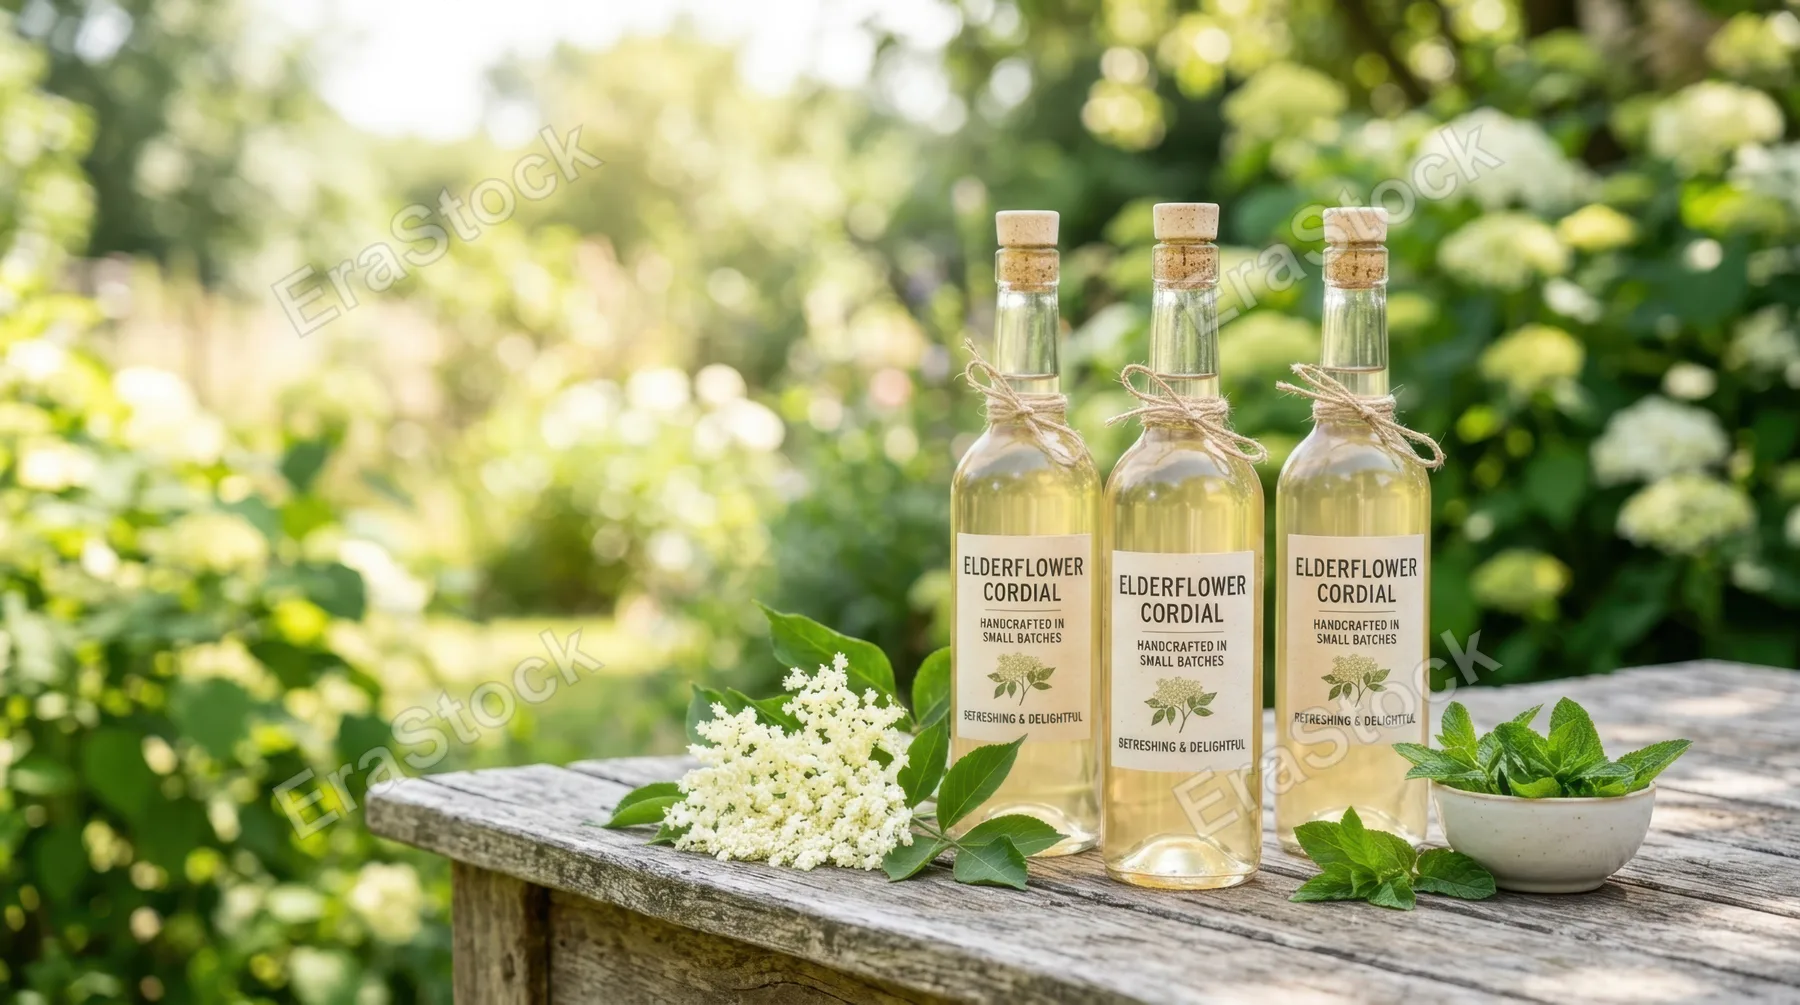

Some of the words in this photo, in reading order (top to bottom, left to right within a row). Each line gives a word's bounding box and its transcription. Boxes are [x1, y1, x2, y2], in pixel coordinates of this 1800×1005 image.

[964, 556, 1083, 577] ELDERFLOWER
[1296, 557, 1417, 578] ELDERFLOWER
[984, 582, 1061, 602] CORDIAL
[1120, 575, 1246, 597] ELDERFLOWER
[1318, 583, 1396, 603] CORDIAL
[1141, 602, 1224, 623] CORDIAL
[980, 618, 1051, 630] HANDCRAFTED
[1055, 618, 1064, 628] IN
[1314, 619, 1387, 631] HANDCRAFTED
[1390, 619, 1399, 630] IN
[983, 632, 1014, 643] SMALL
[1017, 632, 1061, 643] BATCHES
[1317, 633, 1349, 645] SMALL
[1353, 634, 1396, 645] BATCHES
[1138, 640, 1214, 654] HANDCRAFTED
[1217, 640, 1226, 651] IN
[1140, 655, 1174, 667] SMALL
[1178, 654, 1224, 667] BATCHES
[1019, 714, 1025, 724] &
[1029, 712, 1083, 724] DELIGHTFUL
[1354, 715, 1361, 726] &
[1179, 742, 1186, 753] &
[1190, 739, 1245, 752] DELIGHTFUL
